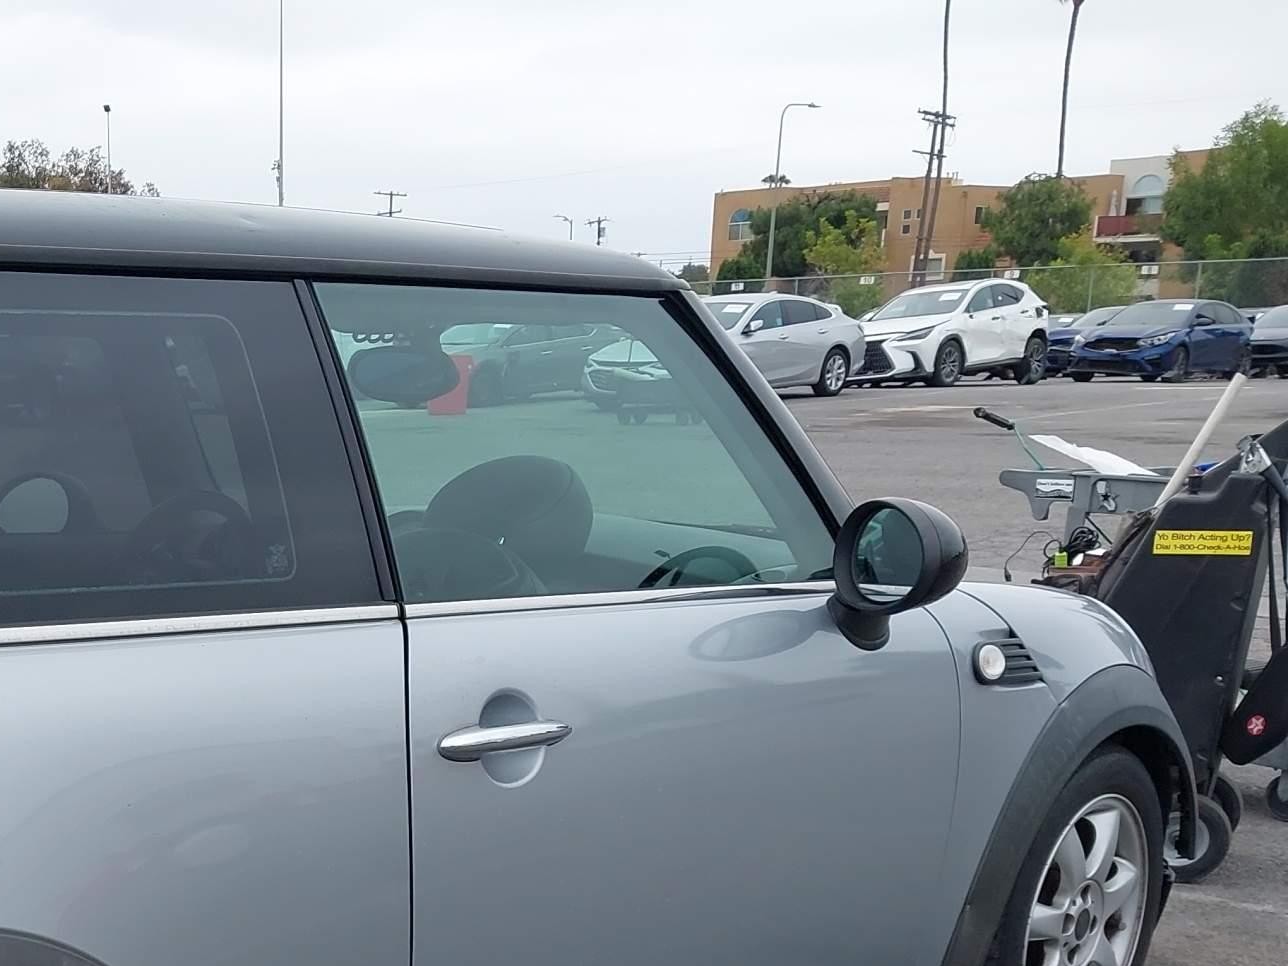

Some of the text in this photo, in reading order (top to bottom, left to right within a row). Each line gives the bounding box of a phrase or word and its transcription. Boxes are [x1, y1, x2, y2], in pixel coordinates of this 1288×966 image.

[1157, 533, 1251, 543] Yo Bitch Acting Up?
[1155, 543, 1171, 551] Dial
